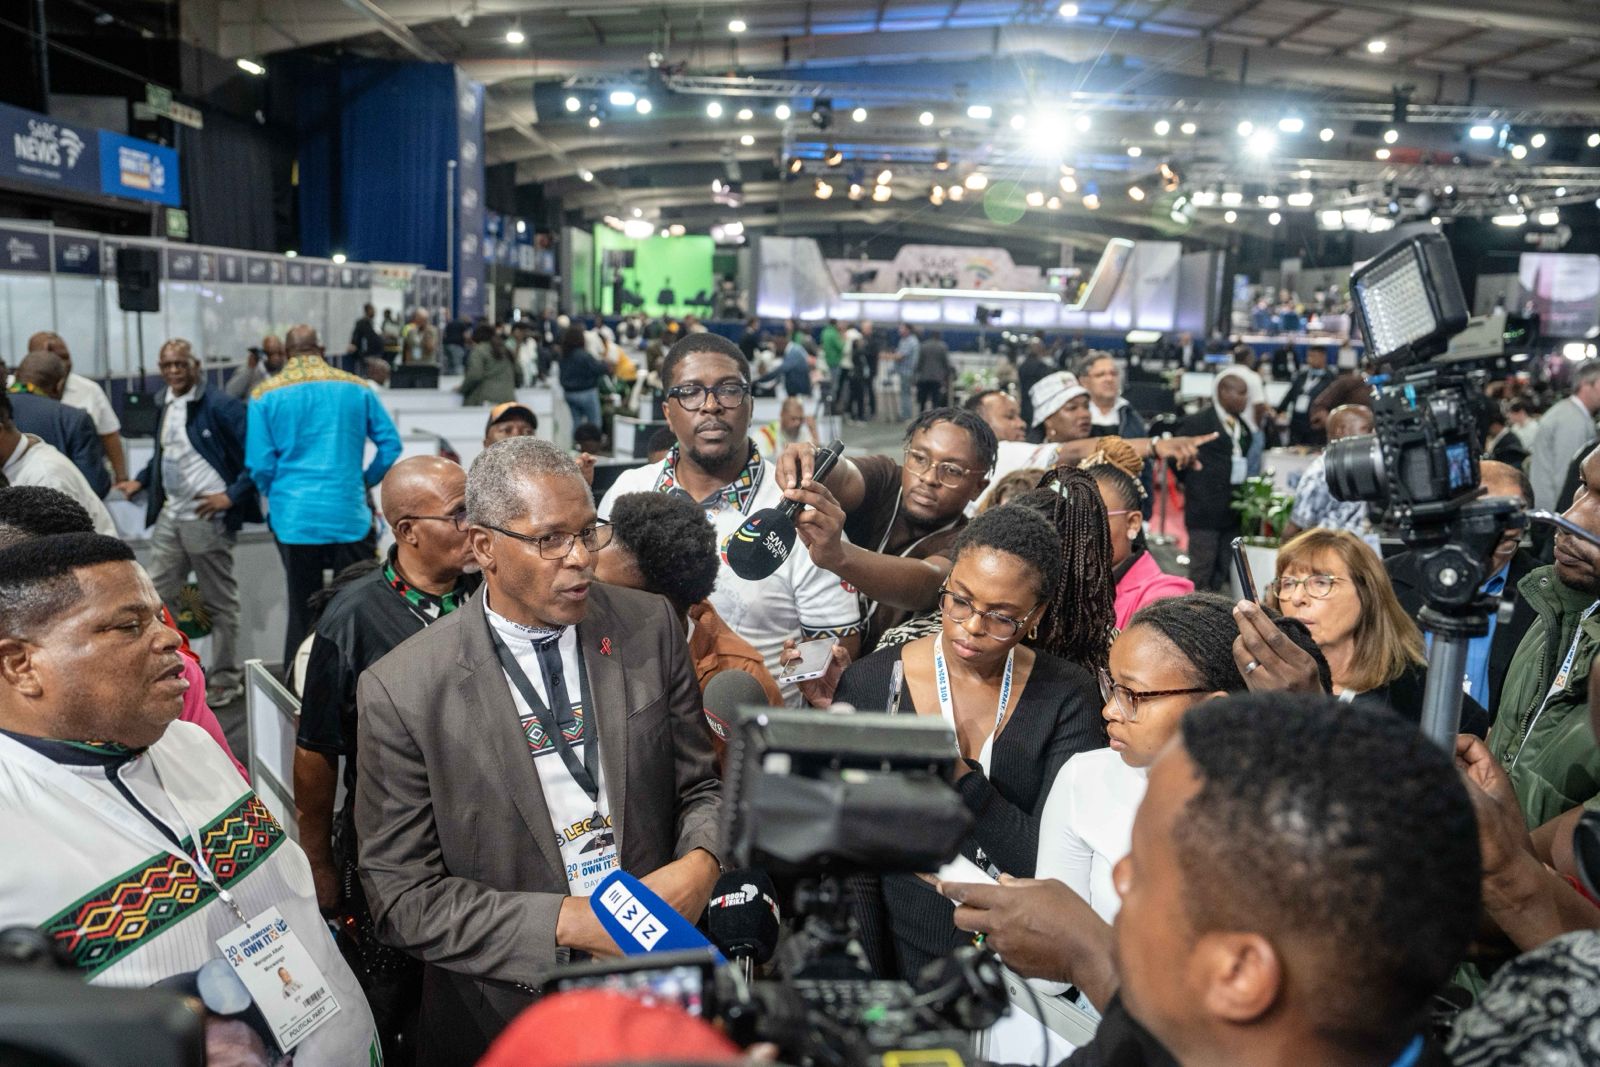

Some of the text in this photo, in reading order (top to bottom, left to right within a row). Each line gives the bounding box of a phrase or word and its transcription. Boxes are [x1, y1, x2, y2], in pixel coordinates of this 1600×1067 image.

[28, 119, 59, 141] SABC
[14, 132, 61, 167] NEWS
[762, 537, 779, 558] SABC
[767, 531, 790, 561] NEWS
[938, 669, 946, 685] 2024
[940, 685, 948, 703] VOTE
[567, 863, 578, 873] 20
[568, 872, 579, 881] 24
[582, 860, 611, 877] OWN IT
[225, 945, 238, 959] 20
[243, 939, 265, 958] OWN
[263, 932, 273, 946] IT
[231, 955, 244, 967] 24
[289, 1016, 314, 1038] POLITICAL
[312, 1006, 326, 1021] PARTY
